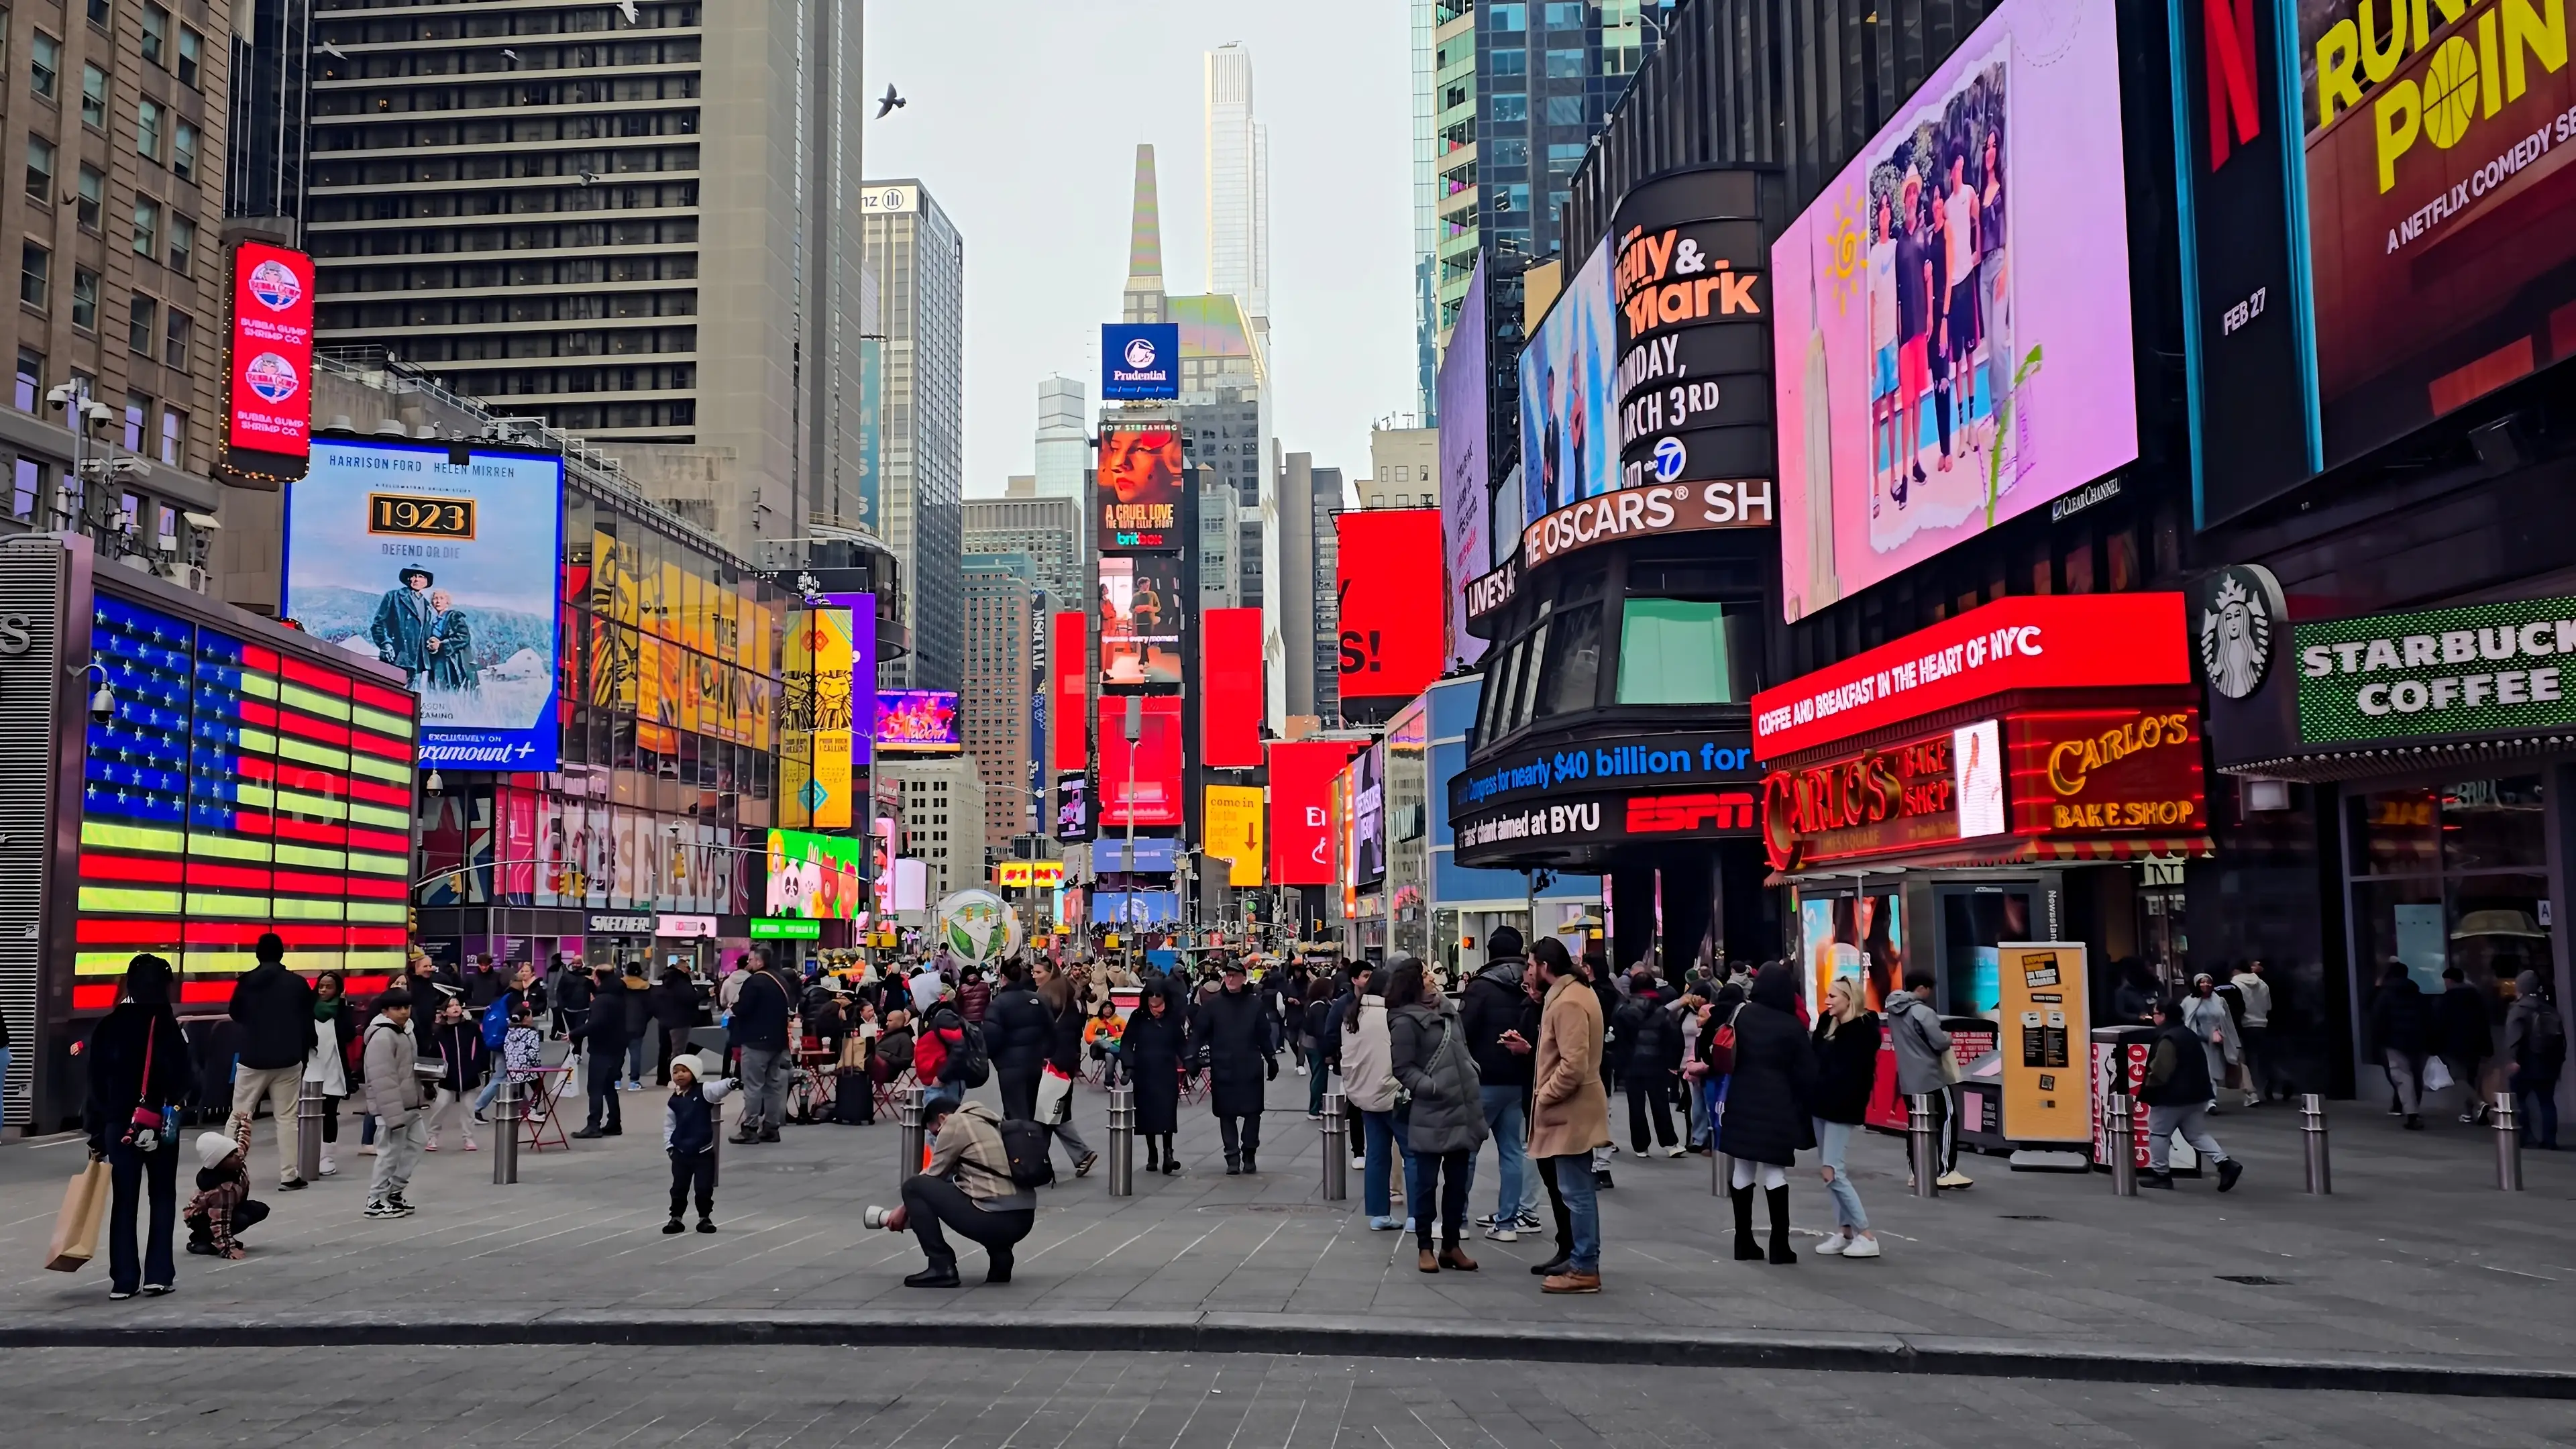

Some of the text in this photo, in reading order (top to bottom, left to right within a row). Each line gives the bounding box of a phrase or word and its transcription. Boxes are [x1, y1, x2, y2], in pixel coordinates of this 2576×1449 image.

[2387, 229, 2400, 255] A
[2400, 178, 2470, 245] NETFLIX
[2471, 122, 2553, 197] COMEDY
[1625, 259, 1760, 340] Mark
[2223, 286, 2266, 336] FEB 27
[241, 317, 307, 336] BUBBA GUMP
[244, 327, 302, 345] SHRIMP CO.
[1114, 370, 1166, 380] Prudential
[1619, 334, 1687, 403] MONDAY,
[237, 411, 304, 428] BUBBA GUMP
[1670, 382, 1719, 427] 3RD
[241, 421, 299, 437] SHRIMP CO.
[329, 455, 422, 472] HARRISON FORD
[472, 465, 515, 478] MIRREN
[380, 500, 465, 531] 1923
[1106, 504, 1174, 521] A CRUEL LOVE
[1703, 482, 1772, 523] SH
[1106, 519, 1118, 529] THE
[1155, 519, 1174, 529] STORY
[1117, 532, 1163, 545] britbox
[382, 543, 460, 559] DEFEND OR DIE
[1758, 625, 2043, 737] COFFEE AND BREAKFAST IN THE HEART OF NYC
[2357, 667, 2561, 716] COFFEE
[429, 733, 485, 743] EXCLUSIVELY
[1512, 757, 1551, 789] nearly
[1554, 751, 1589, 784] $40
[1595, 745, 1691, 777] billion
[1701, 742, 1750, 771] for
[1904, 741, 1947, 777] BAKE
[2047, 714, 2188, 796] CARLO'S
[1211, 797, 1254, 808] come in
[1904, 779, 1949, 816] SHOP
[1531, 809, 1547, 836] at
[1550, 802, 1600, 834] BYU
[1625, 793, 1754, 833] ESPN
[2053, 800, 2194, 829] BAKE SHOP
